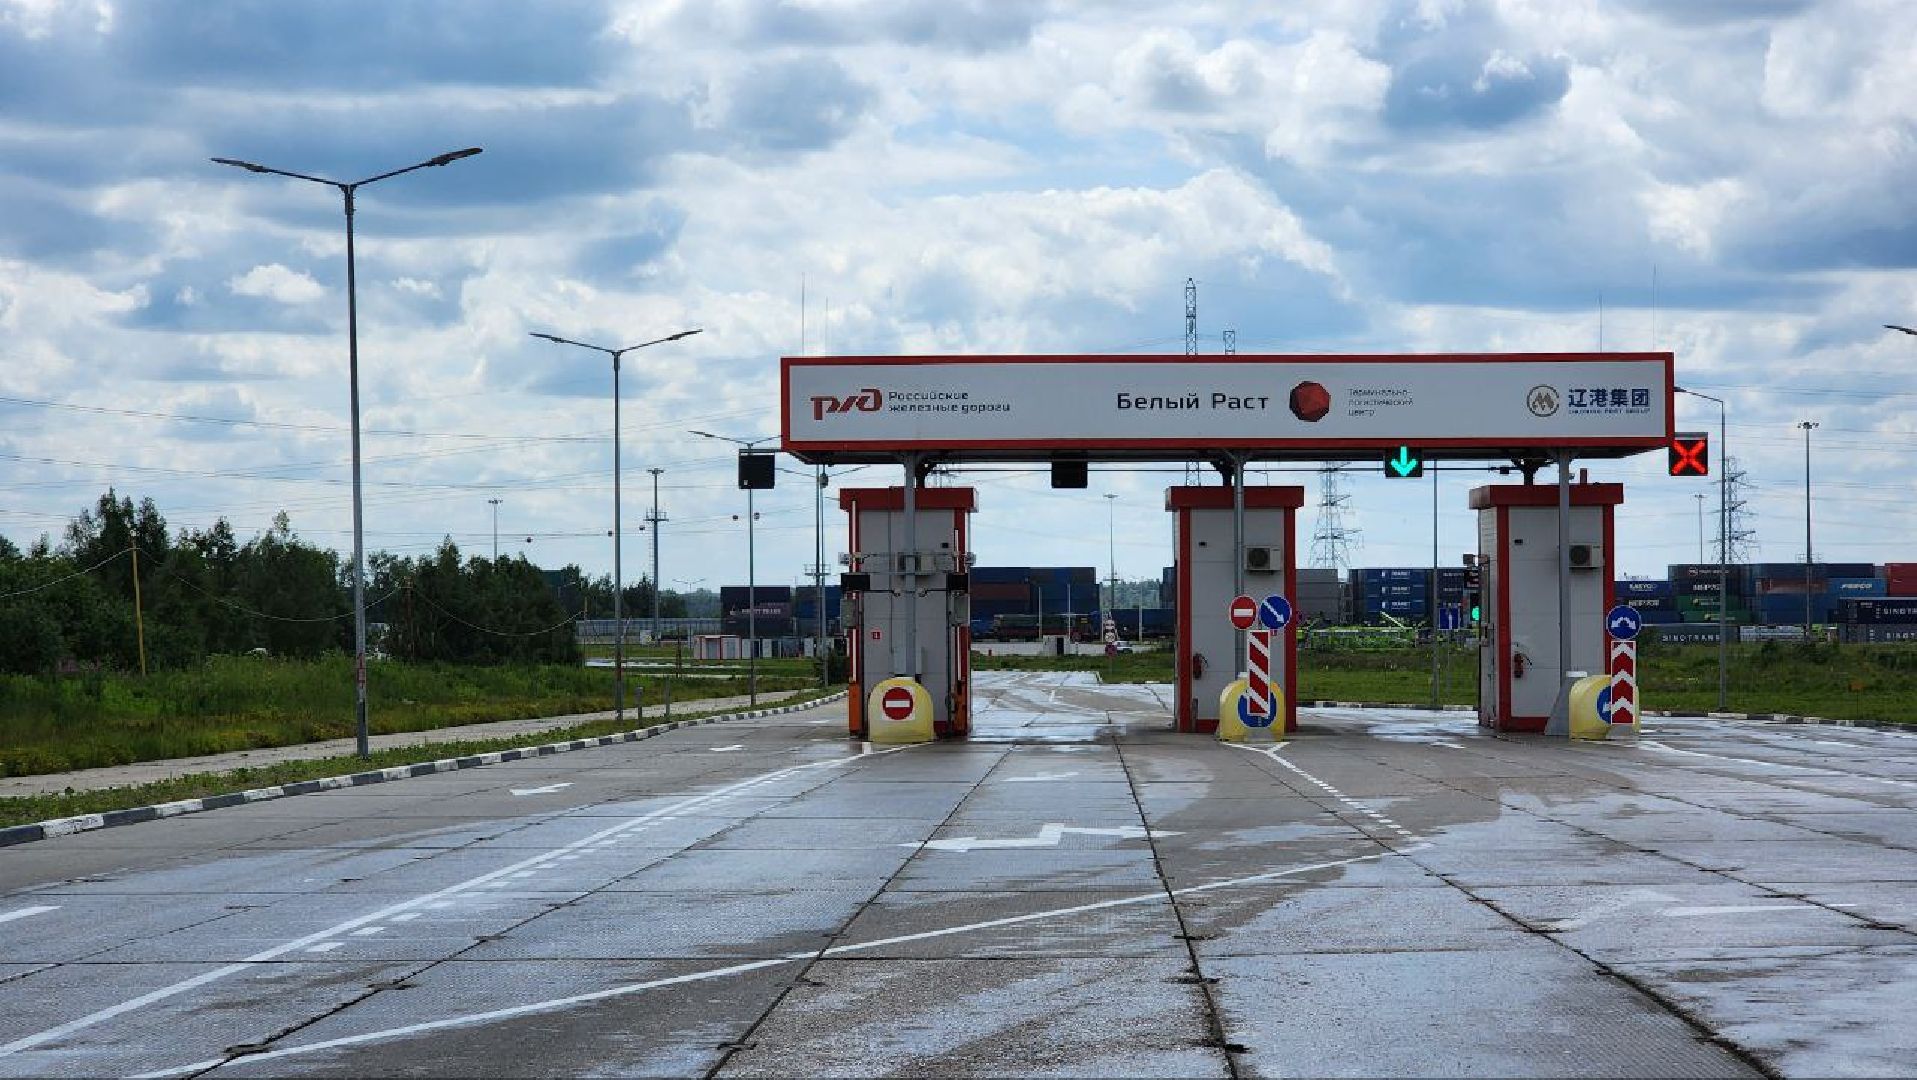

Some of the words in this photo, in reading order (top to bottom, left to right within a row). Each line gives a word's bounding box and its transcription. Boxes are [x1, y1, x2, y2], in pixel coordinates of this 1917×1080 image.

[888, 391, 969, 400] Российские
[1117, 392, 1199, 409] Белый
[1211, 392, 1270, 409] Раст
[1568, 388, 1649, 408] 辽港集团
[888, 403, 959, 412] железные
[961, 403, 1011, 414] дороги
